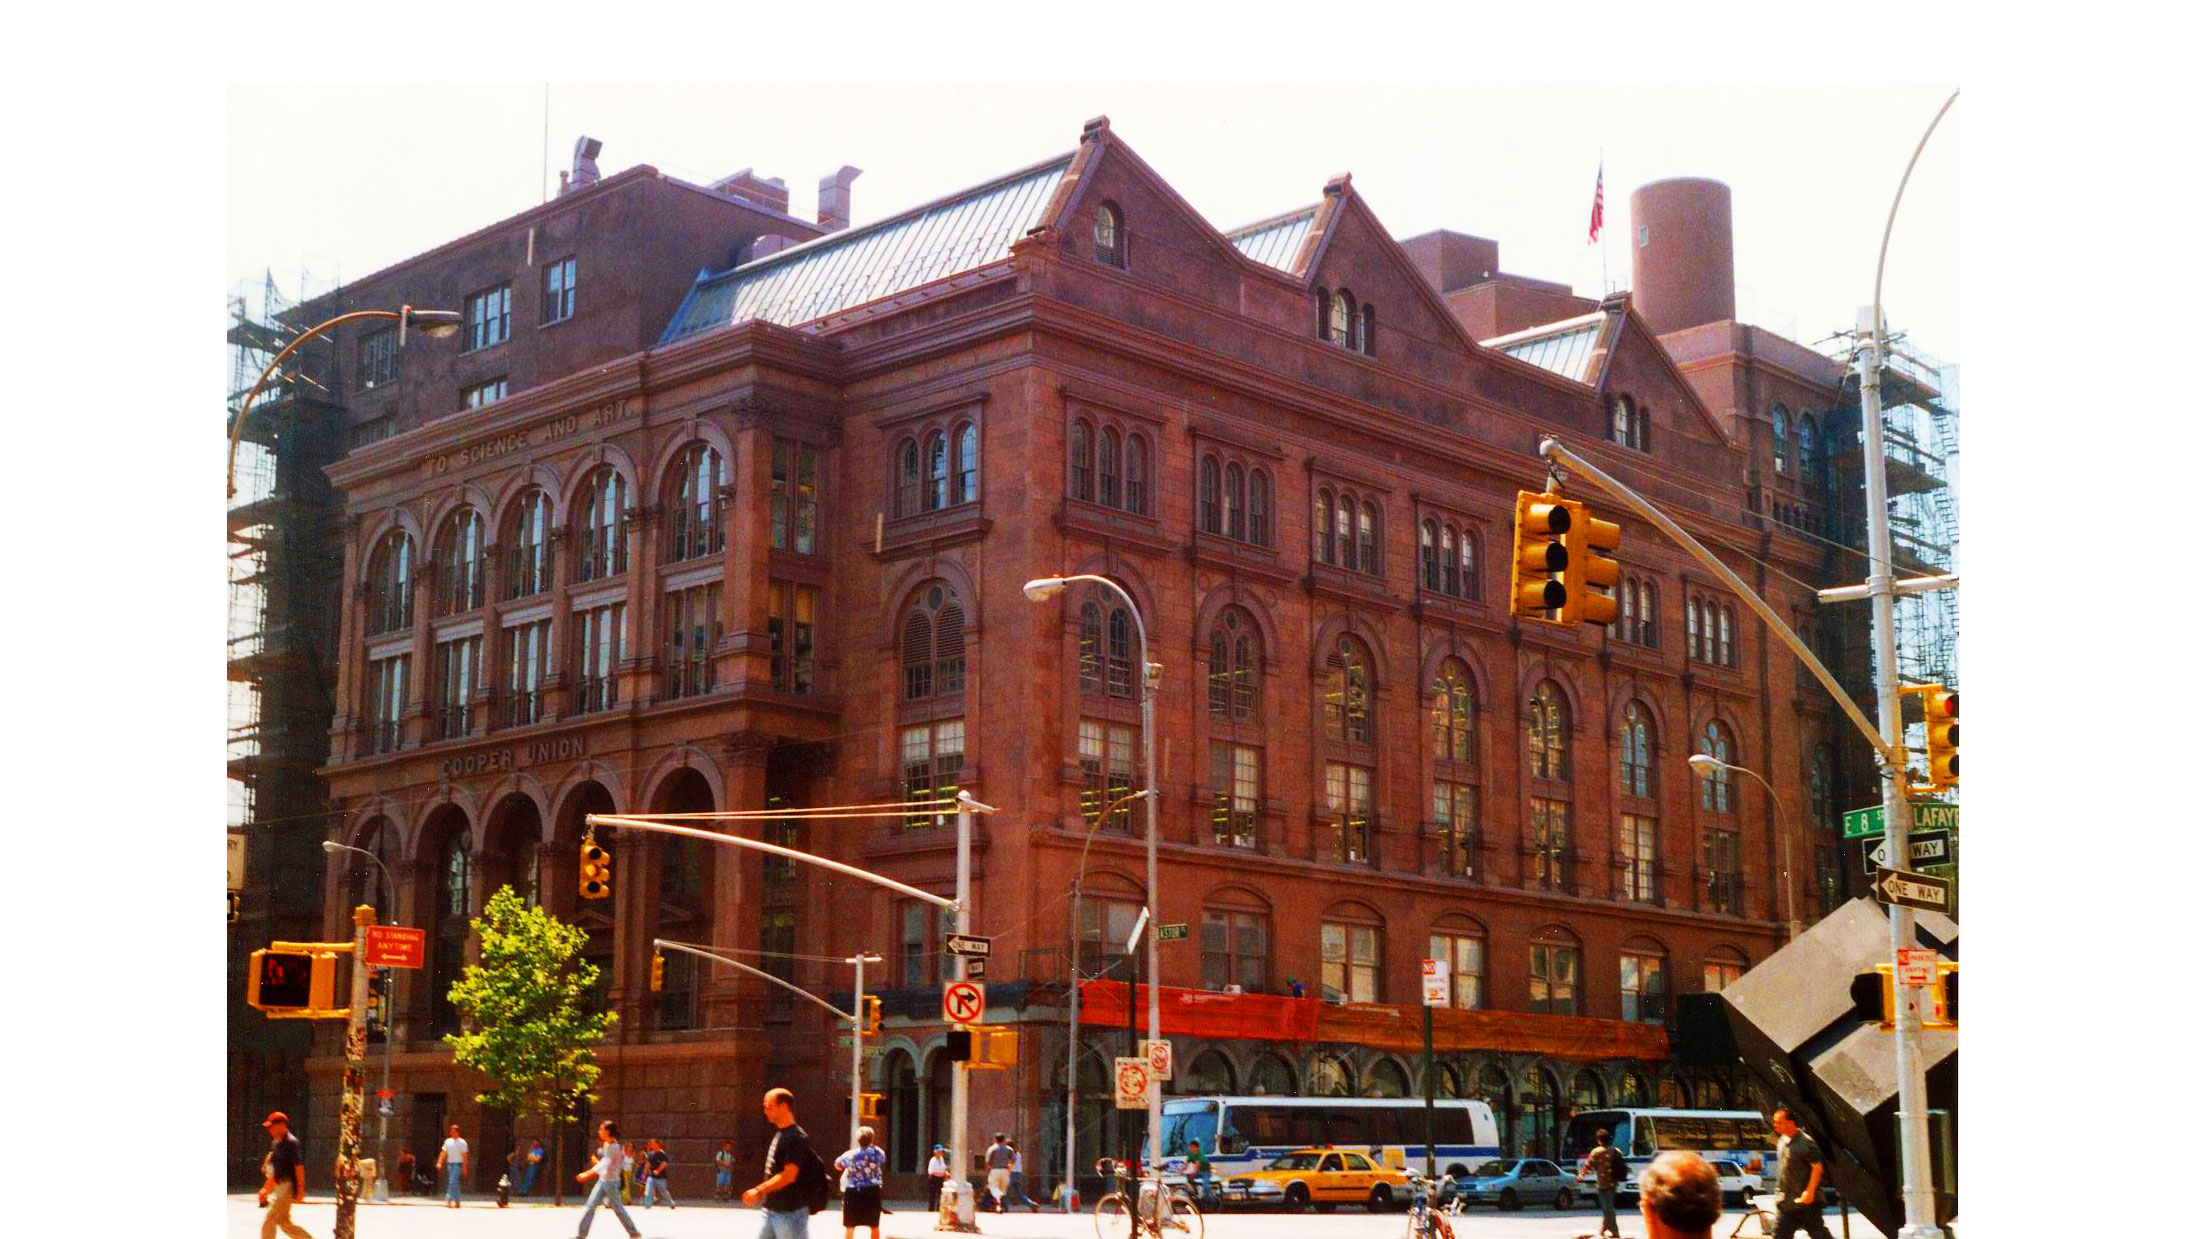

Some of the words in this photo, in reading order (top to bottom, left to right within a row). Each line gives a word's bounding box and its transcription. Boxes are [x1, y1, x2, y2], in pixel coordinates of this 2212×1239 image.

[429, 455, 447, 474] TO
[459, 431, 528, 466] SCIENCE
[544, 416, 577, 441] AND
[443, 749, 513, 776] COOPER
[527, 736, 585, 762] UNION
[1844, 815, 1852, 834] E
[1860, 812, 1869, 832] 8
[1912, 842, 1939, 857] WAY
[1888, 880, 1908, 896] ONE
[1917, 885, 1940, 900] WAY
[376, 942, 412, 951] ANYTIME
